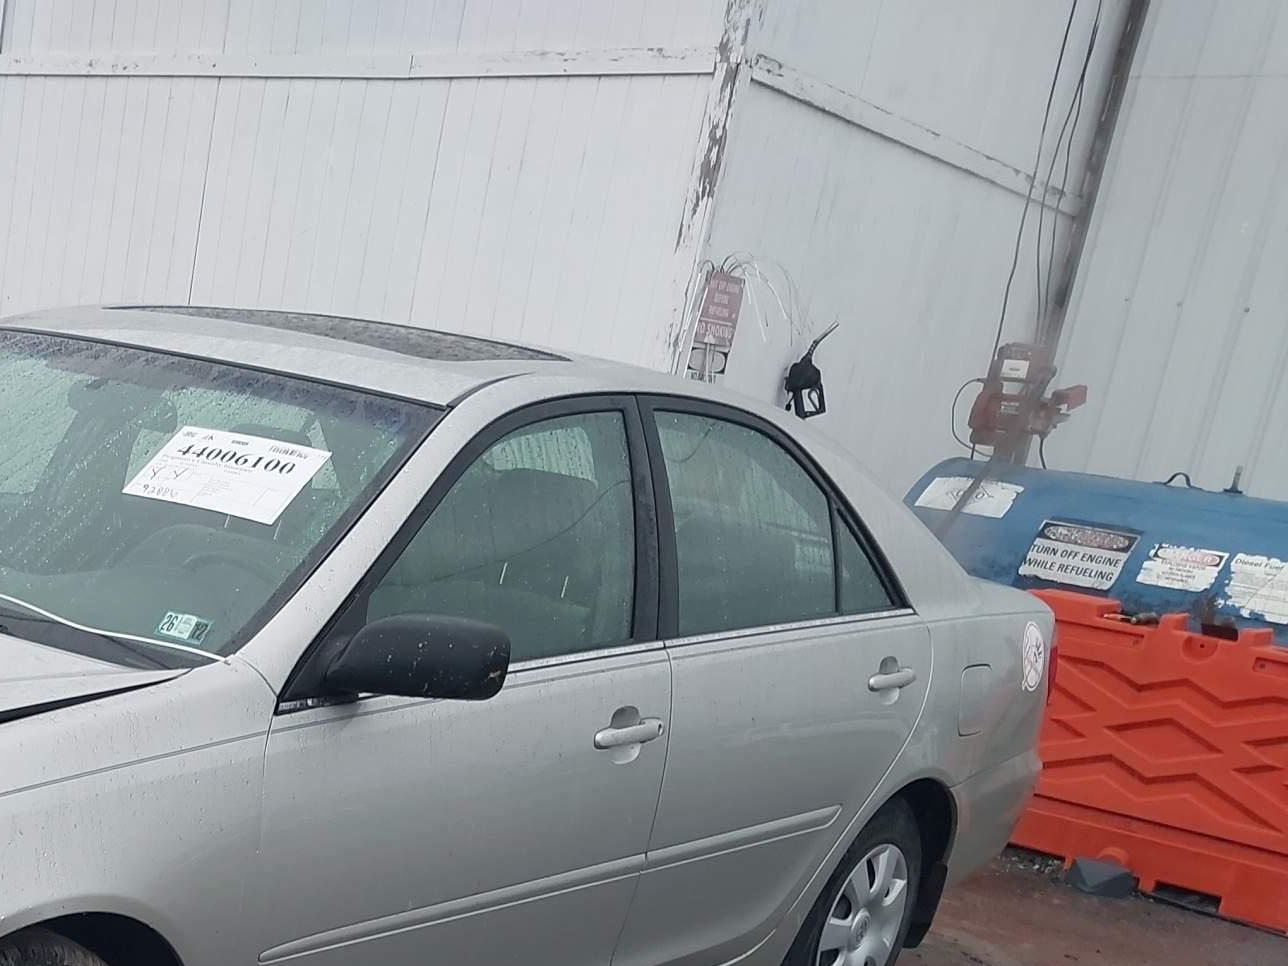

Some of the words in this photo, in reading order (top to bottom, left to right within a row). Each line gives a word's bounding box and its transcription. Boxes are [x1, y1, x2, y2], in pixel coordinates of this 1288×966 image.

[176, 443, 297, 475] 44006100
[1030, 543, 1059, 557] TURN
[1060, 549, 1080, 560] OFF
[1080, 552, 1122, 568] ENGINE
[1234, 558, 1263, 568] Diesel
[1023, 557, 1057, 572] WHILE
[1056, 562, 1114, 582] REFUELING
[160, 614, 179, 632] 26
